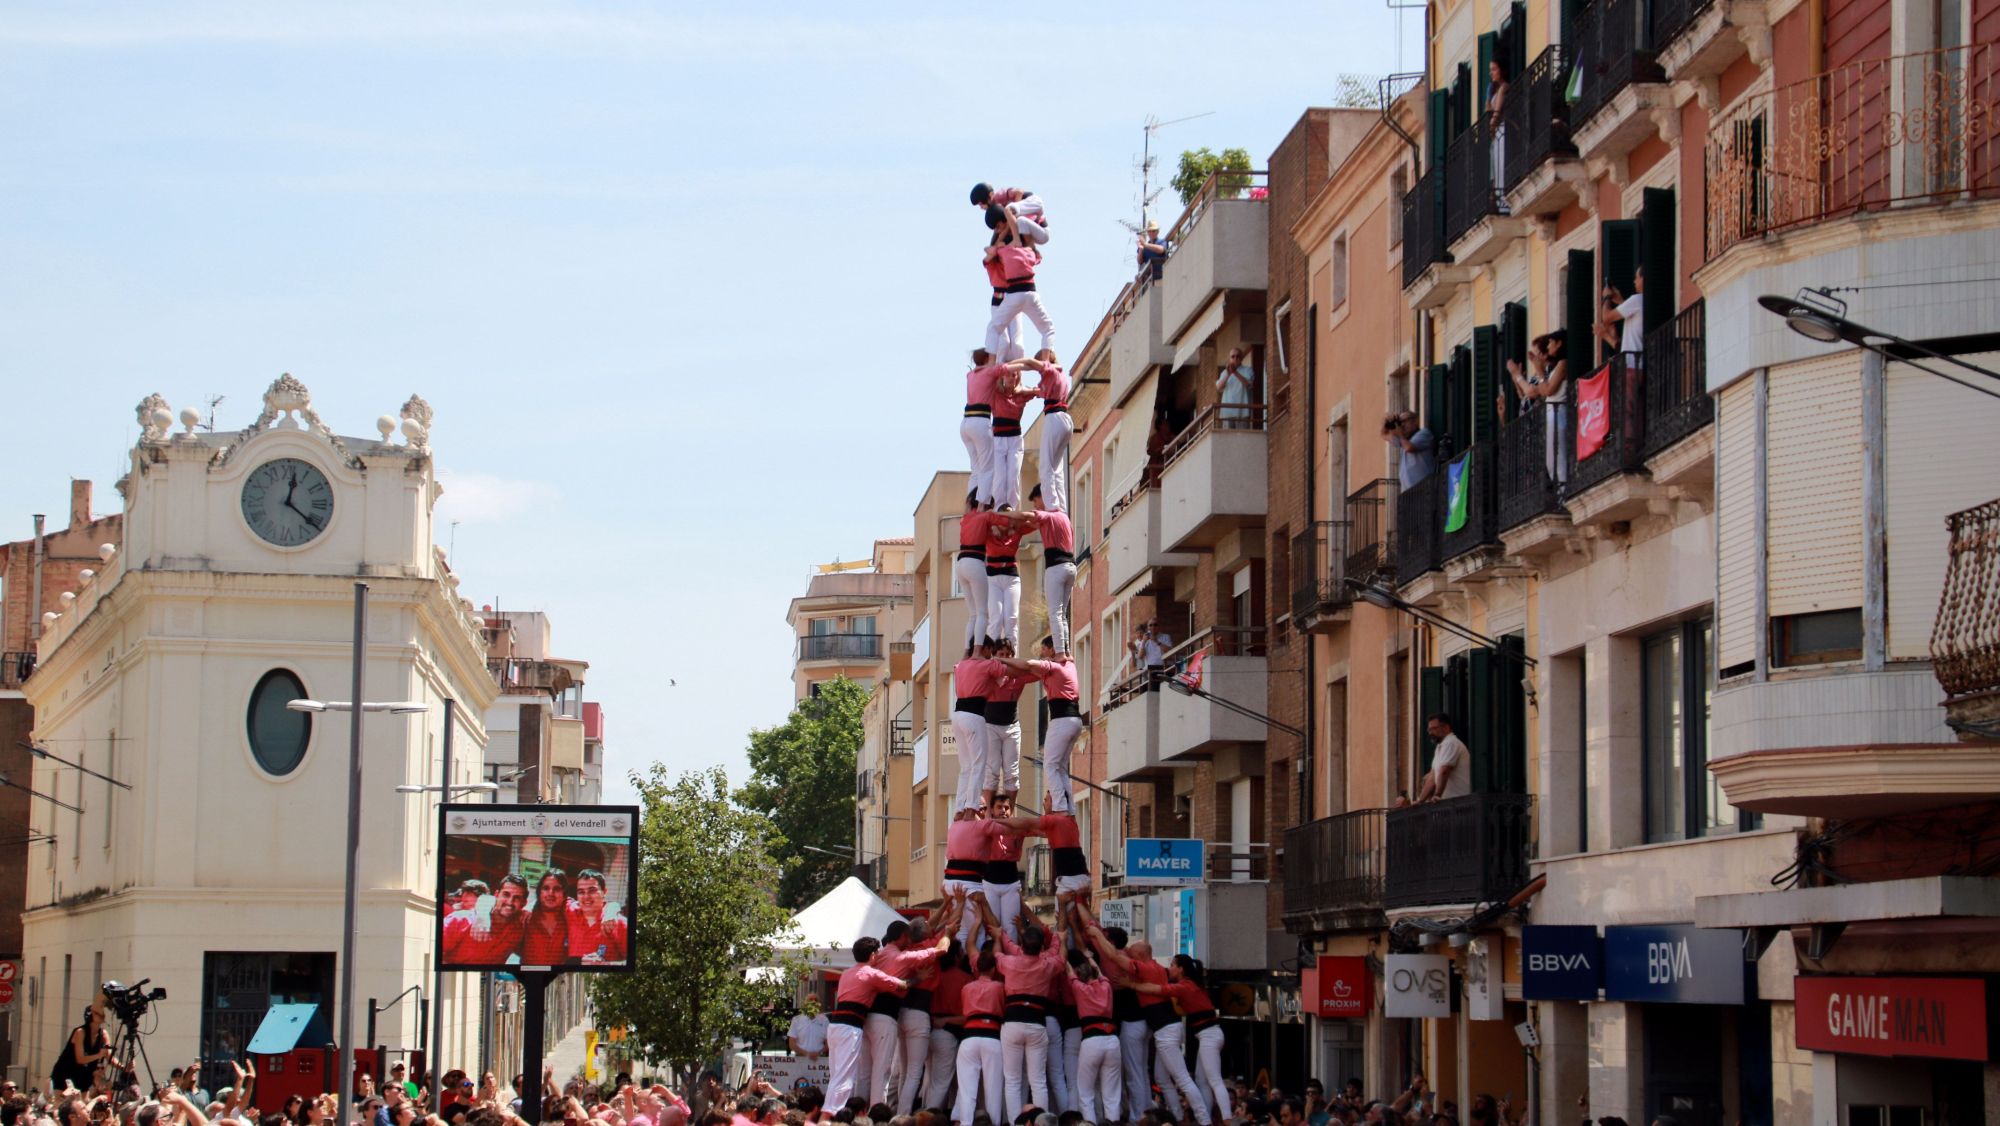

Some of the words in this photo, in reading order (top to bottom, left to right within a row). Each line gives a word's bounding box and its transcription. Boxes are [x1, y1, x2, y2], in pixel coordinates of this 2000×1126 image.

[472, 818, 526, 828] Ajuntament
[554, 818, 568, 828] del
[570, 818, 606, 828] Vendrell
[1138, 858, 1190, 869] MAYER
[1529, 953, 1590, 971] BBVA
[1648, 936, 1692, 984] BBVA
[1392, 968, 1446, 992] OVS
[1323, 999, 1361, 1008] PROXIM
[1828, 993, 1888, 1040] GAME
[1894, 998, 1947, 1045] MAN
